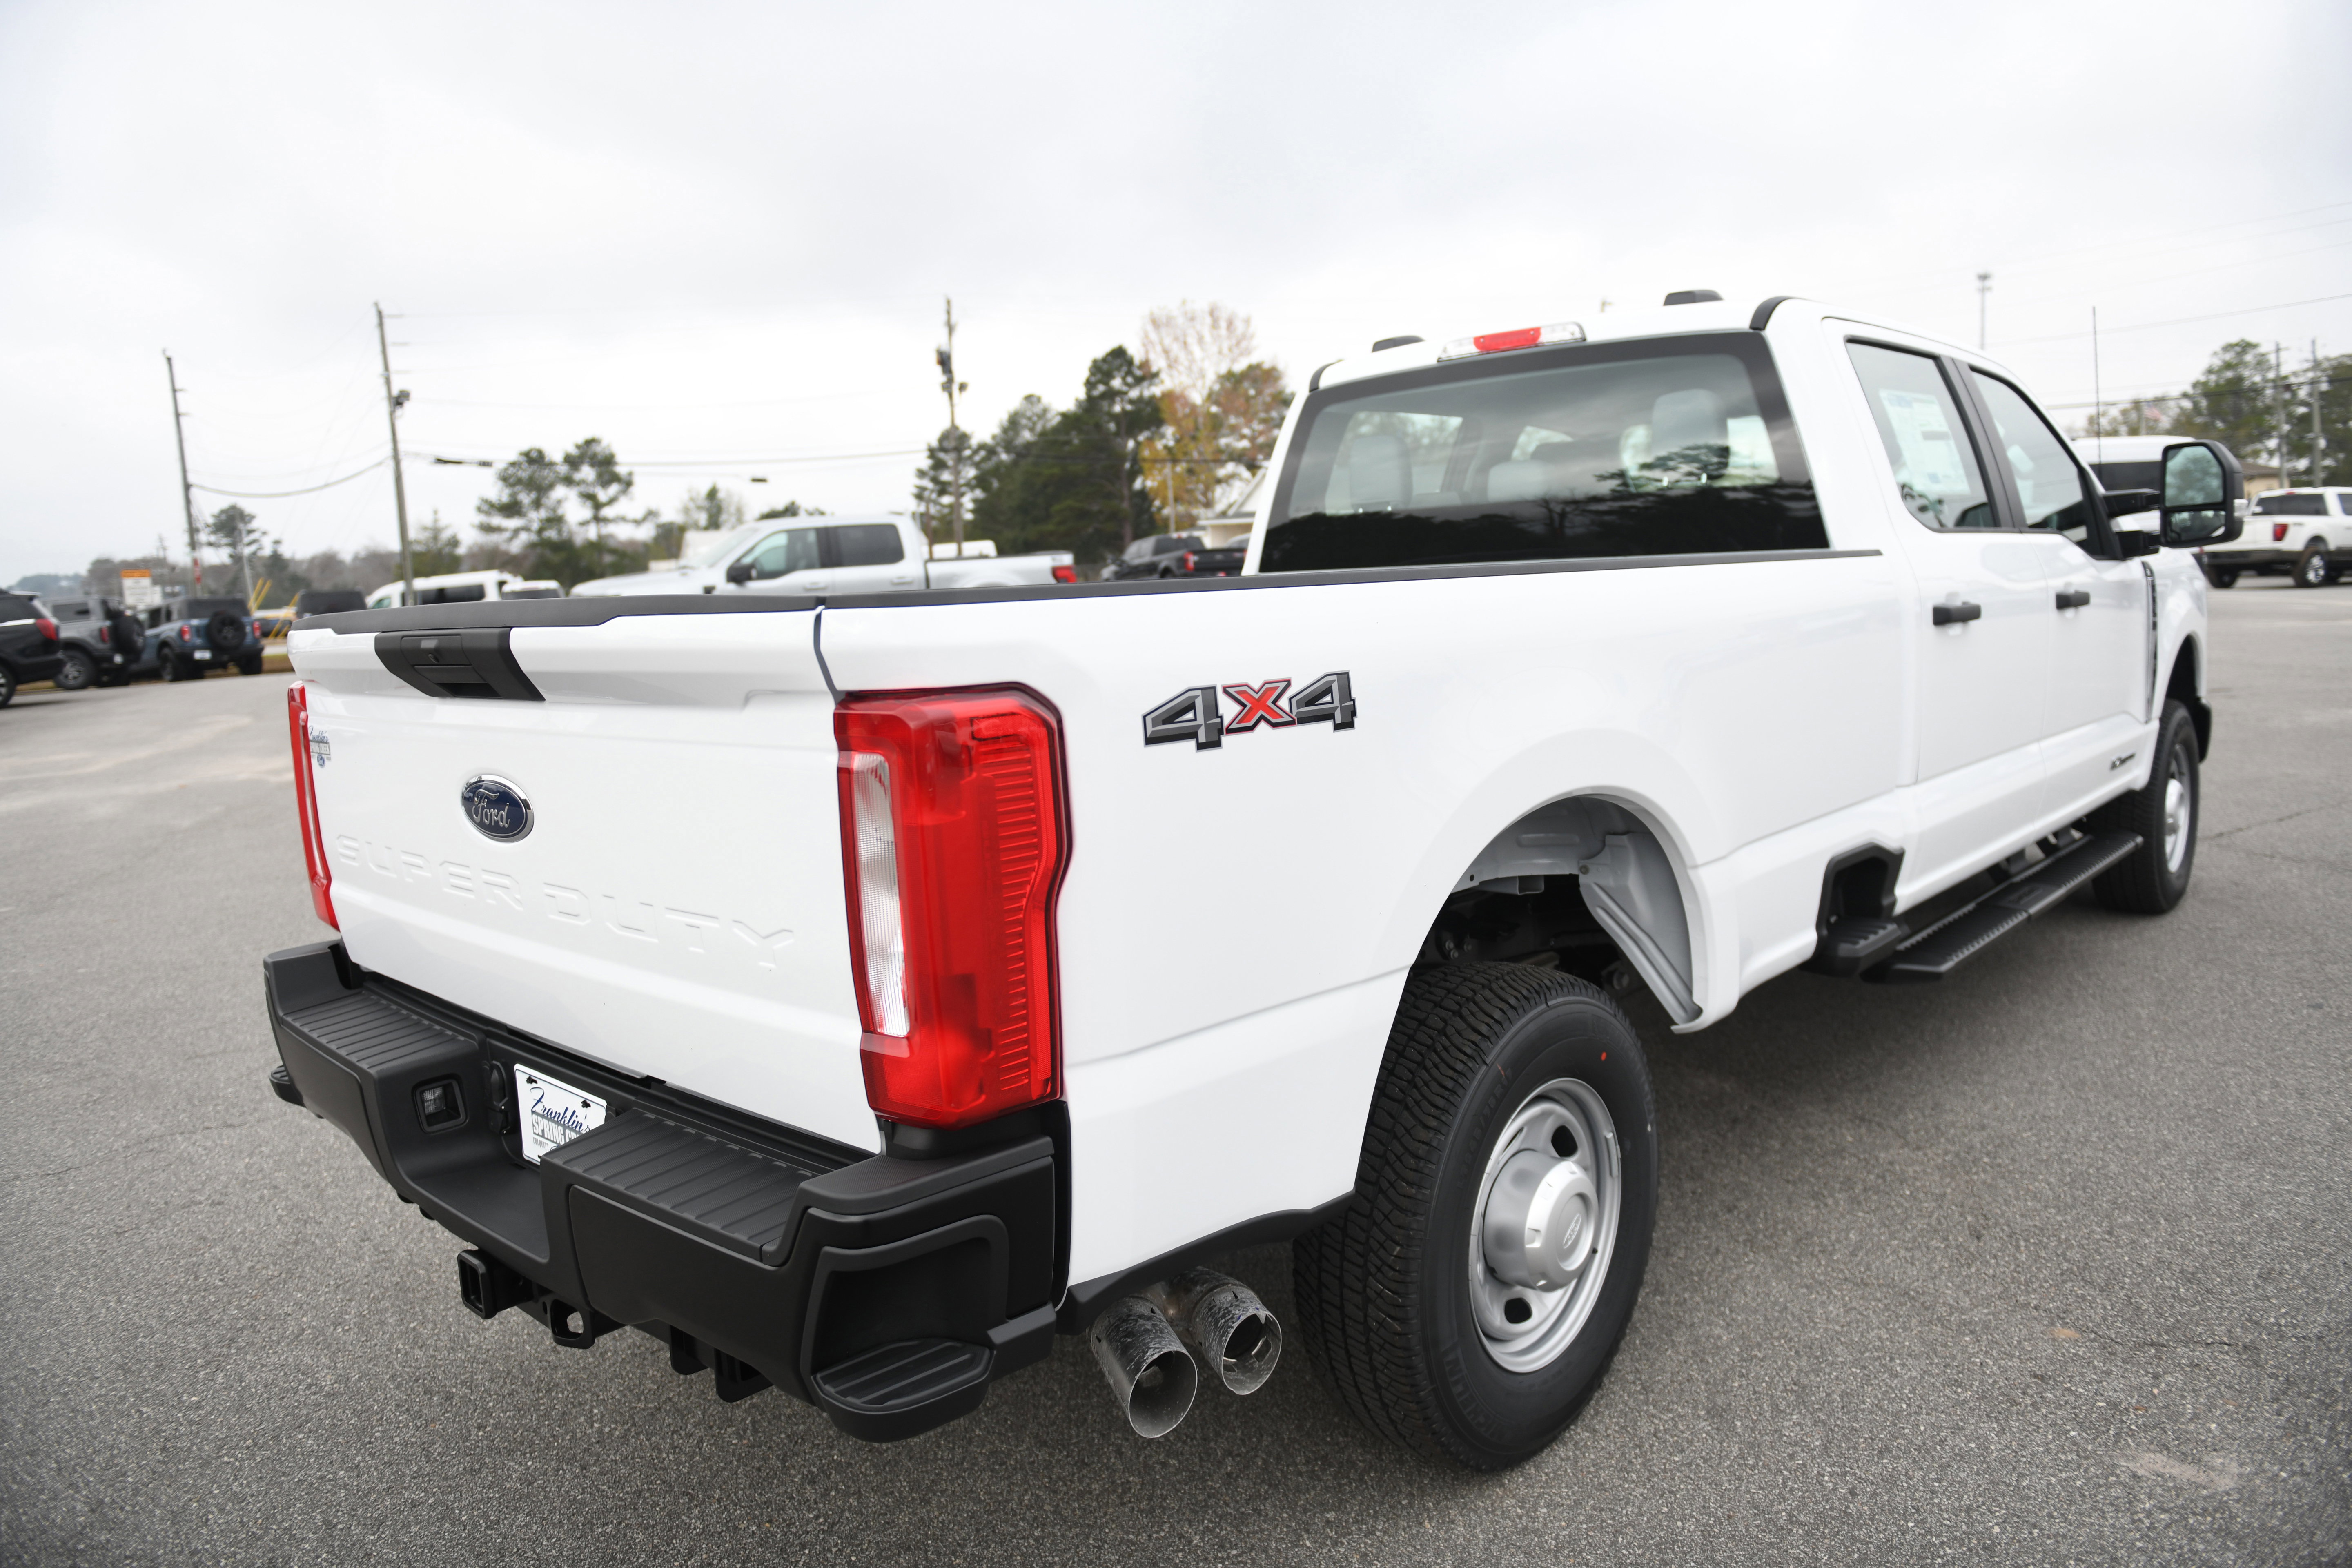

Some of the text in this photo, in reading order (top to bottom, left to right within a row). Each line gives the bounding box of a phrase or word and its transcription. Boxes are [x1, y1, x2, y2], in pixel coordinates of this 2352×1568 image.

[472, 788, 510, 829] Ford
[336, 834, 795, 968] SUPER DUTY
[532, 1114, 565, 1145] SPRING
[533, 1136, 549, 1151] COLQUITT
